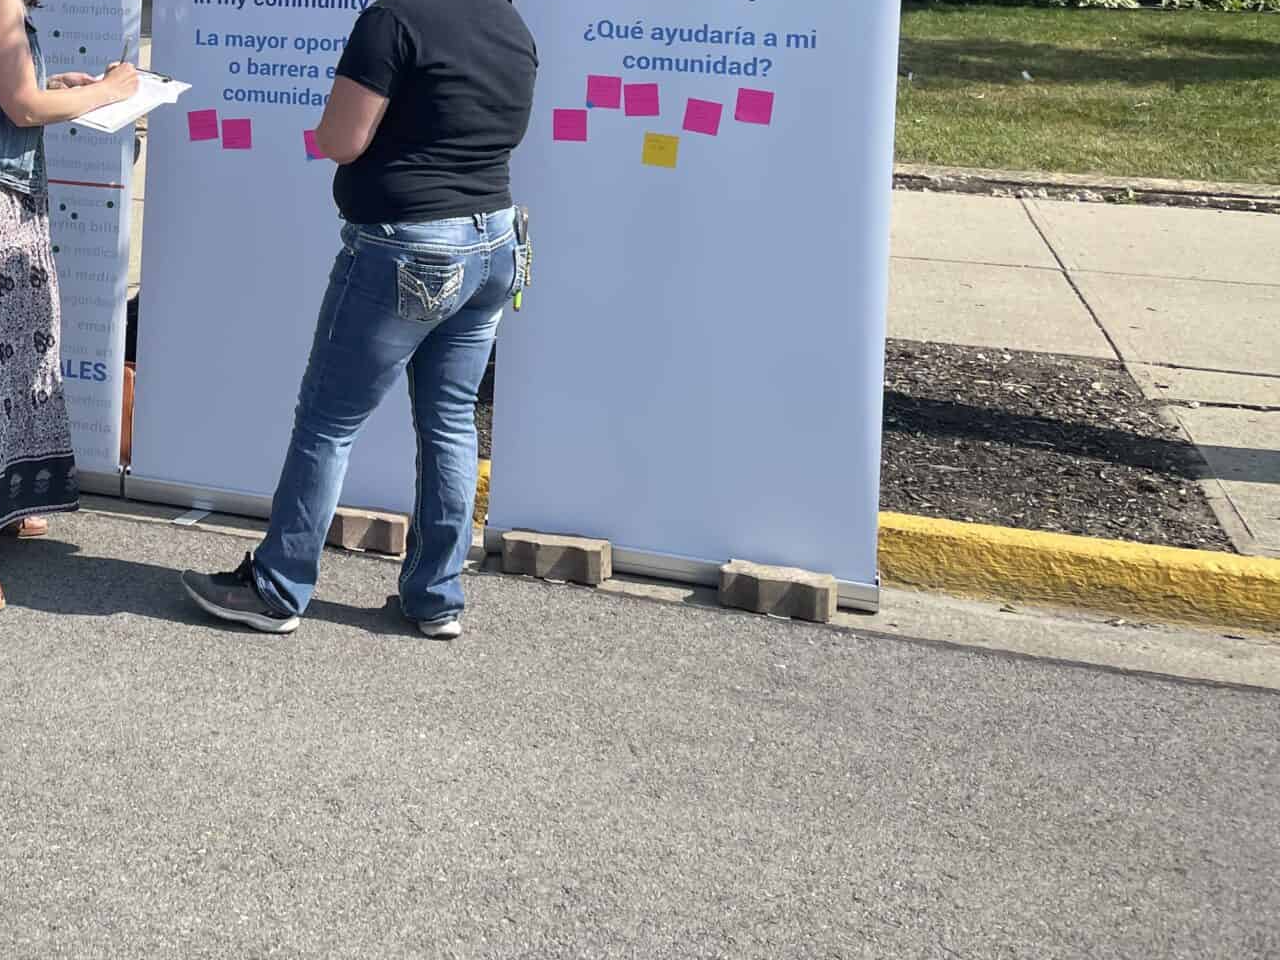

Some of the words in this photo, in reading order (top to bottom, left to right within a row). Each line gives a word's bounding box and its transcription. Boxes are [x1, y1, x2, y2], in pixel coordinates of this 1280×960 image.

[194, 28, 219, 47] La
[224, 33, 288, 52] mayor
[582, 18, 644, 42] ¿Qué
[650, 22, 756, 50] ayudaría
[763, 32, 778, 48] a
[785, 29, 817, 50] mi
[228, 61, 241, 76] o
[247, 57, 319, 79] barrera
[325, 65, 337, 80] e
[622, 53, 773, 78] comunidad?
